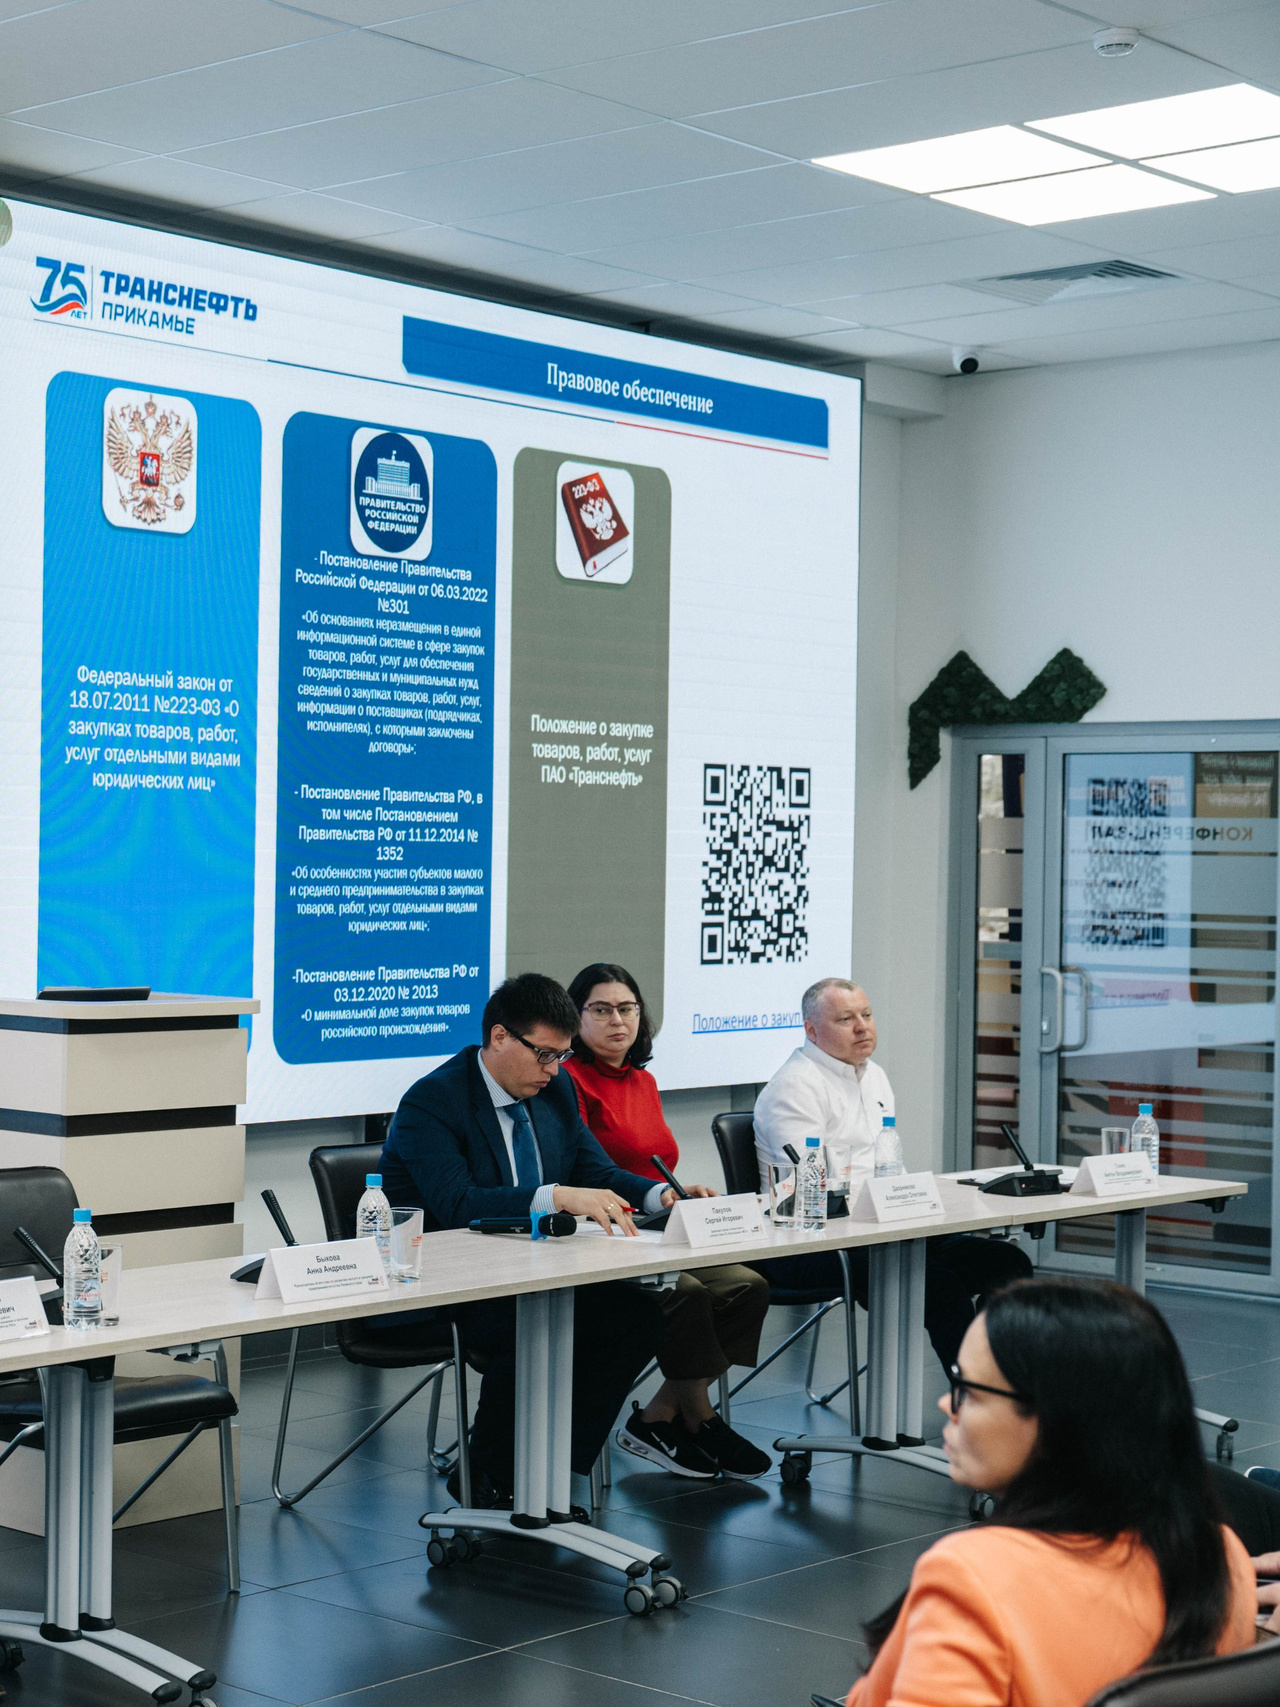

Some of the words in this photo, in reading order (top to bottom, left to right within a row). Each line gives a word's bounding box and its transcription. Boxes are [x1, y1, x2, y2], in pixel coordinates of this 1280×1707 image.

[36, 256, 87, 306] 75
[100, 270, 258, 321] ТРАНСНЕФТЬ
[70, 310, 87, 319] ЛЕТ
[102, 302, 196, 334] ПРИКАМЬЕ
[546, 362, 620, 397] Правовое
[622, 380, 714, 414] обеспечение
[572, 478, 599, 499] 223-ФЗ
[359, 496, 426, 514] ПРАВИТЕЛЬСТВО
[365, 509, 419, 524] РОССИЙСКОЙ
[367, 521, 417, 534] ФЕДЕРАЦИИ
[320, 551, 398, 572] Постановление
[401, 560, 472, 581] Правительства
[295, 569, 357, 589] Российской
[359, 576, 416, 596] Федерации
[418, 585, 429, 596] от
[431, 584, 488, 603] 06.03.2022
[378, 598, 410, 614] №301
[302, 611, 318, 624] «Об
[321, 615, 374, 629] основаниях
[376, 620, 441, 635] неразмещения
[444, 625, 449, 635] в
[451, 626, 481, 638] единой
[297, 630, 377, 647] информационной
[380, 638, 415, 650] системе
[417, 640, 423, 650] в
[425, 640, 451, 654] сфере
[453, 644, 485, 656] закупок
[308, 649, 348, 664] товаров,
[350, 651, 377, 666] работ,
[380, 656, 401, 668] услуг
[403, 657, 418, 669] для
[420, 657, 474, 672] обеспечения
[77, 665, 173, 689] Федеральный
[177, 675, 216, 692] закон
[219, 678, 233, 693] от
[303, 666, 380, 682] государственных
[382, 673, 387, 682] и
[390, 673, 456, 688] муниципальных
[459, 678, 479, 690] нужд
[70, 690, 150, 713] 18.07.2011
[154, 694, 221, 716] №223-ФЗ
[224, 699, 239, 717] «О
[298, 684, 342, 698] сведений
[344, 688, 350, 698] о
[352, 689, 392, 702] закупках
[393, 691, 431, 705] товаров,
[433, 693, 458, 706] работ,
[460, 696, 482, 708] услуг,
[297, 702, 356, 717] информации
[358, 706, 363, 716] о
[366, 706, 423, 720] поставщиках
[425, 708, 483, 724] (подрядчиках,
[69, 720, 131, 740] закупках
[135, 723, 193, 742] товаров,
[197, 724, 238, 745] работ,
[307, 720, 373, 736] исполнителях),
[375, 725, 380, 734] с
[383, 726, 426, 740] которыми
[428, 728, 474, 740] заключены
[531, 714, 597, 735] Положение
[599, 722, 607, 735] о
[609, 722, 654, 740] закупке
[65, 745, 101, 764] услуг
[104, 747, 187, 764] отдельными
[191, 751, 241, 768] видами
[532, 743, 583, 762] товаров,
[586, 742, 621, 763] работ,
[624, 748, 652, 766] услуг
[93, 772, 184, 791] юридических
[187, 775, 216, 792] лиц»
[541, 765, 566, 784] ПАО
[569, 766, 643, 789] «Транснефть»
[301, 785, 380, 801] Постановление
[383, 787, 455, 804] Правительства
[458, 790, 474, 805] РФ,
[477, 793, 483, 804] в
[322, 808, 341, 820] том
[343, 809, 372, 821] числе
[375, 807, 458, 823] Постановлением
[299, 826, 375, 843] Правительства
[378, 828, 393, 841] РФ
[395, 831, 406, 841] от
[408, 828, 465, 842] 11.12.2014
[467, 829, 478, 842] №
[376, 847, 404, 861] 1352
[291, 866, 308, 879] «Об
[310, 866, 372, 880] особенностях
[374, 869, 407, 882] участия
[410, 868, 452, 882] субъектов
[454, 869, 483, 880] малого
[290, 886, 296, 896] и
[298, 885, 340, 899] среднего
[342, 885, 438, 898] предпринимательства
[440, 885, 446, 895] в
[447, 885, 484, 898] закупках
[297, 902, 336, 917] товаров,
[339, 902, 367, 917] работ,
[369, 903, 390, 916] услуг
[392, 902, 444, 914] отдельными
[446, 902, 477, 914] видами
[348, 921, 407, 934] юридических
[292, 969, 376, 984] -Постановление
[378, 966, 450, 983] Правительства
[452, 965, 467, 978] РФ
[469, 967, 479, 977] от
[334, 987, 395, 1003] 03.12.2020
[398, 987, 410, 1000] №
[412, 985, 439, 999] 2013
[301, 1009, 312, 1022] «О
[314, 1006, 377, 1021] минимальной
[379, 1008, 398, 1019] доле
[401, 1007, 434, 1021] закупок
[436, 1004, 470, 1018] товаров
[693, 1013, 758, 1031] Положение
[761, 1014, 768, 1026] о
[771, 1012, 800, 1027] закуп
[321, 1026, 377, 1042] российского
[316, 1254, 340, 1263] Быкова
[324, 1262, 357, 1273] Андреевна
